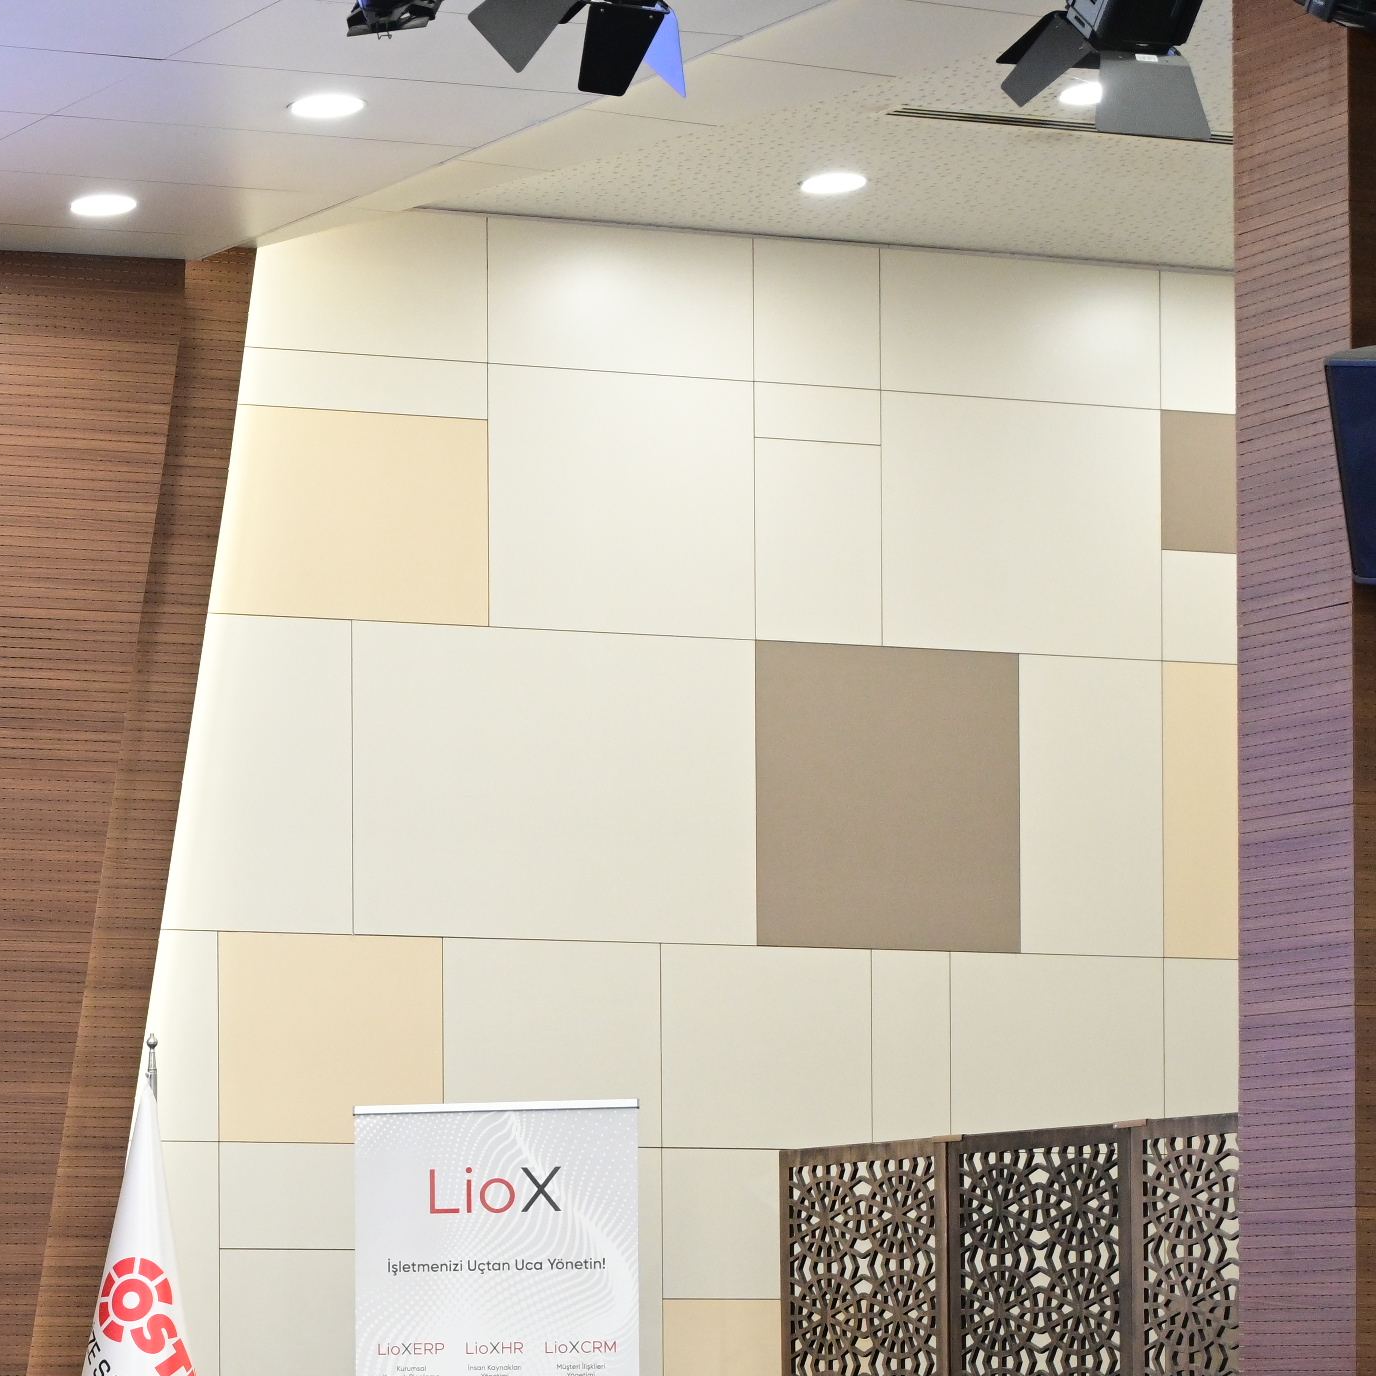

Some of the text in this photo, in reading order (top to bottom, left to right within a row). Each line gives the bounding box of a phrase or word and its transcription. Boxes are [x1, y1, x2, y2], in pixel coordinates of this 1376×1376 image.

[430, 1166, 561, 1214] LioX
[388, 1258, 605, 1276] İşletmenizi Uçtan Uca Yönetin!
[377, 1342, 445, 1356] LioXERP
[465, 1341, 524, 1355] LioXHR
[544, 1340, 618, 1354] LioXCRM
